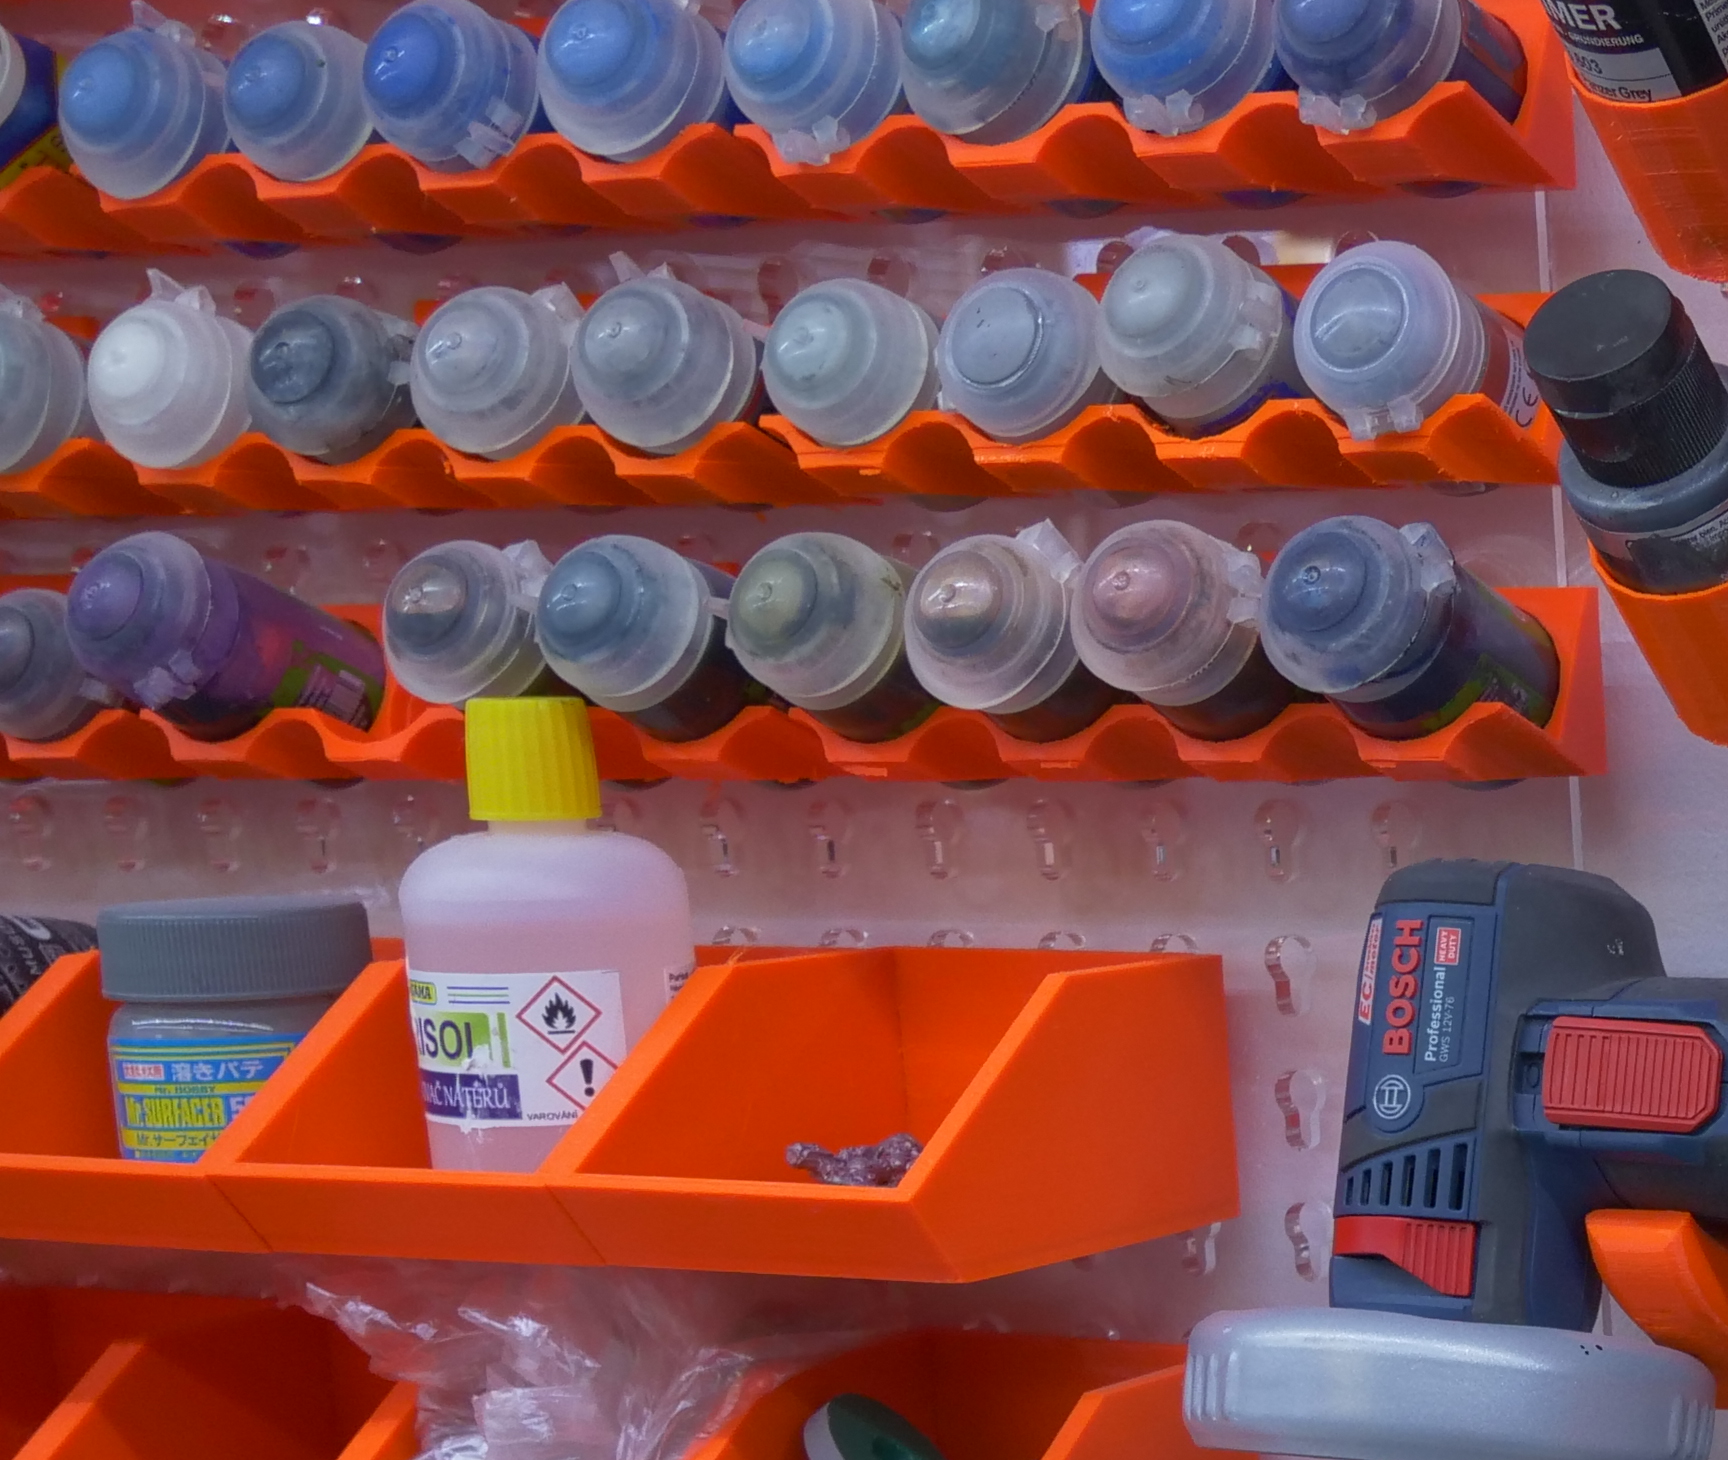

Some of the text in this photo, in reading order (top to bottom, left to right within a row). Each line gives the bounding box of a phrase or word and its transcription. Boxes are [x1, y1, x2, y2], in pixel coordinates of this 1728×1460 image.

[1545, 0, 1622, 31] MER
[1370, 925, 1380, 976] motor
[1438, 930, 1449, 962] HEAVY
[1448, 934, 1458, 959] DUTY
[1358, 981, 1373, 1021] EC
[1382, 919, 1424, 1055] BOSCH
[1424, 966, 1446, 1062] Professional
[1439, 1036, 1450, 1063] GWS
[526, 1110, 578, 1121] VAROVÁNÍ
